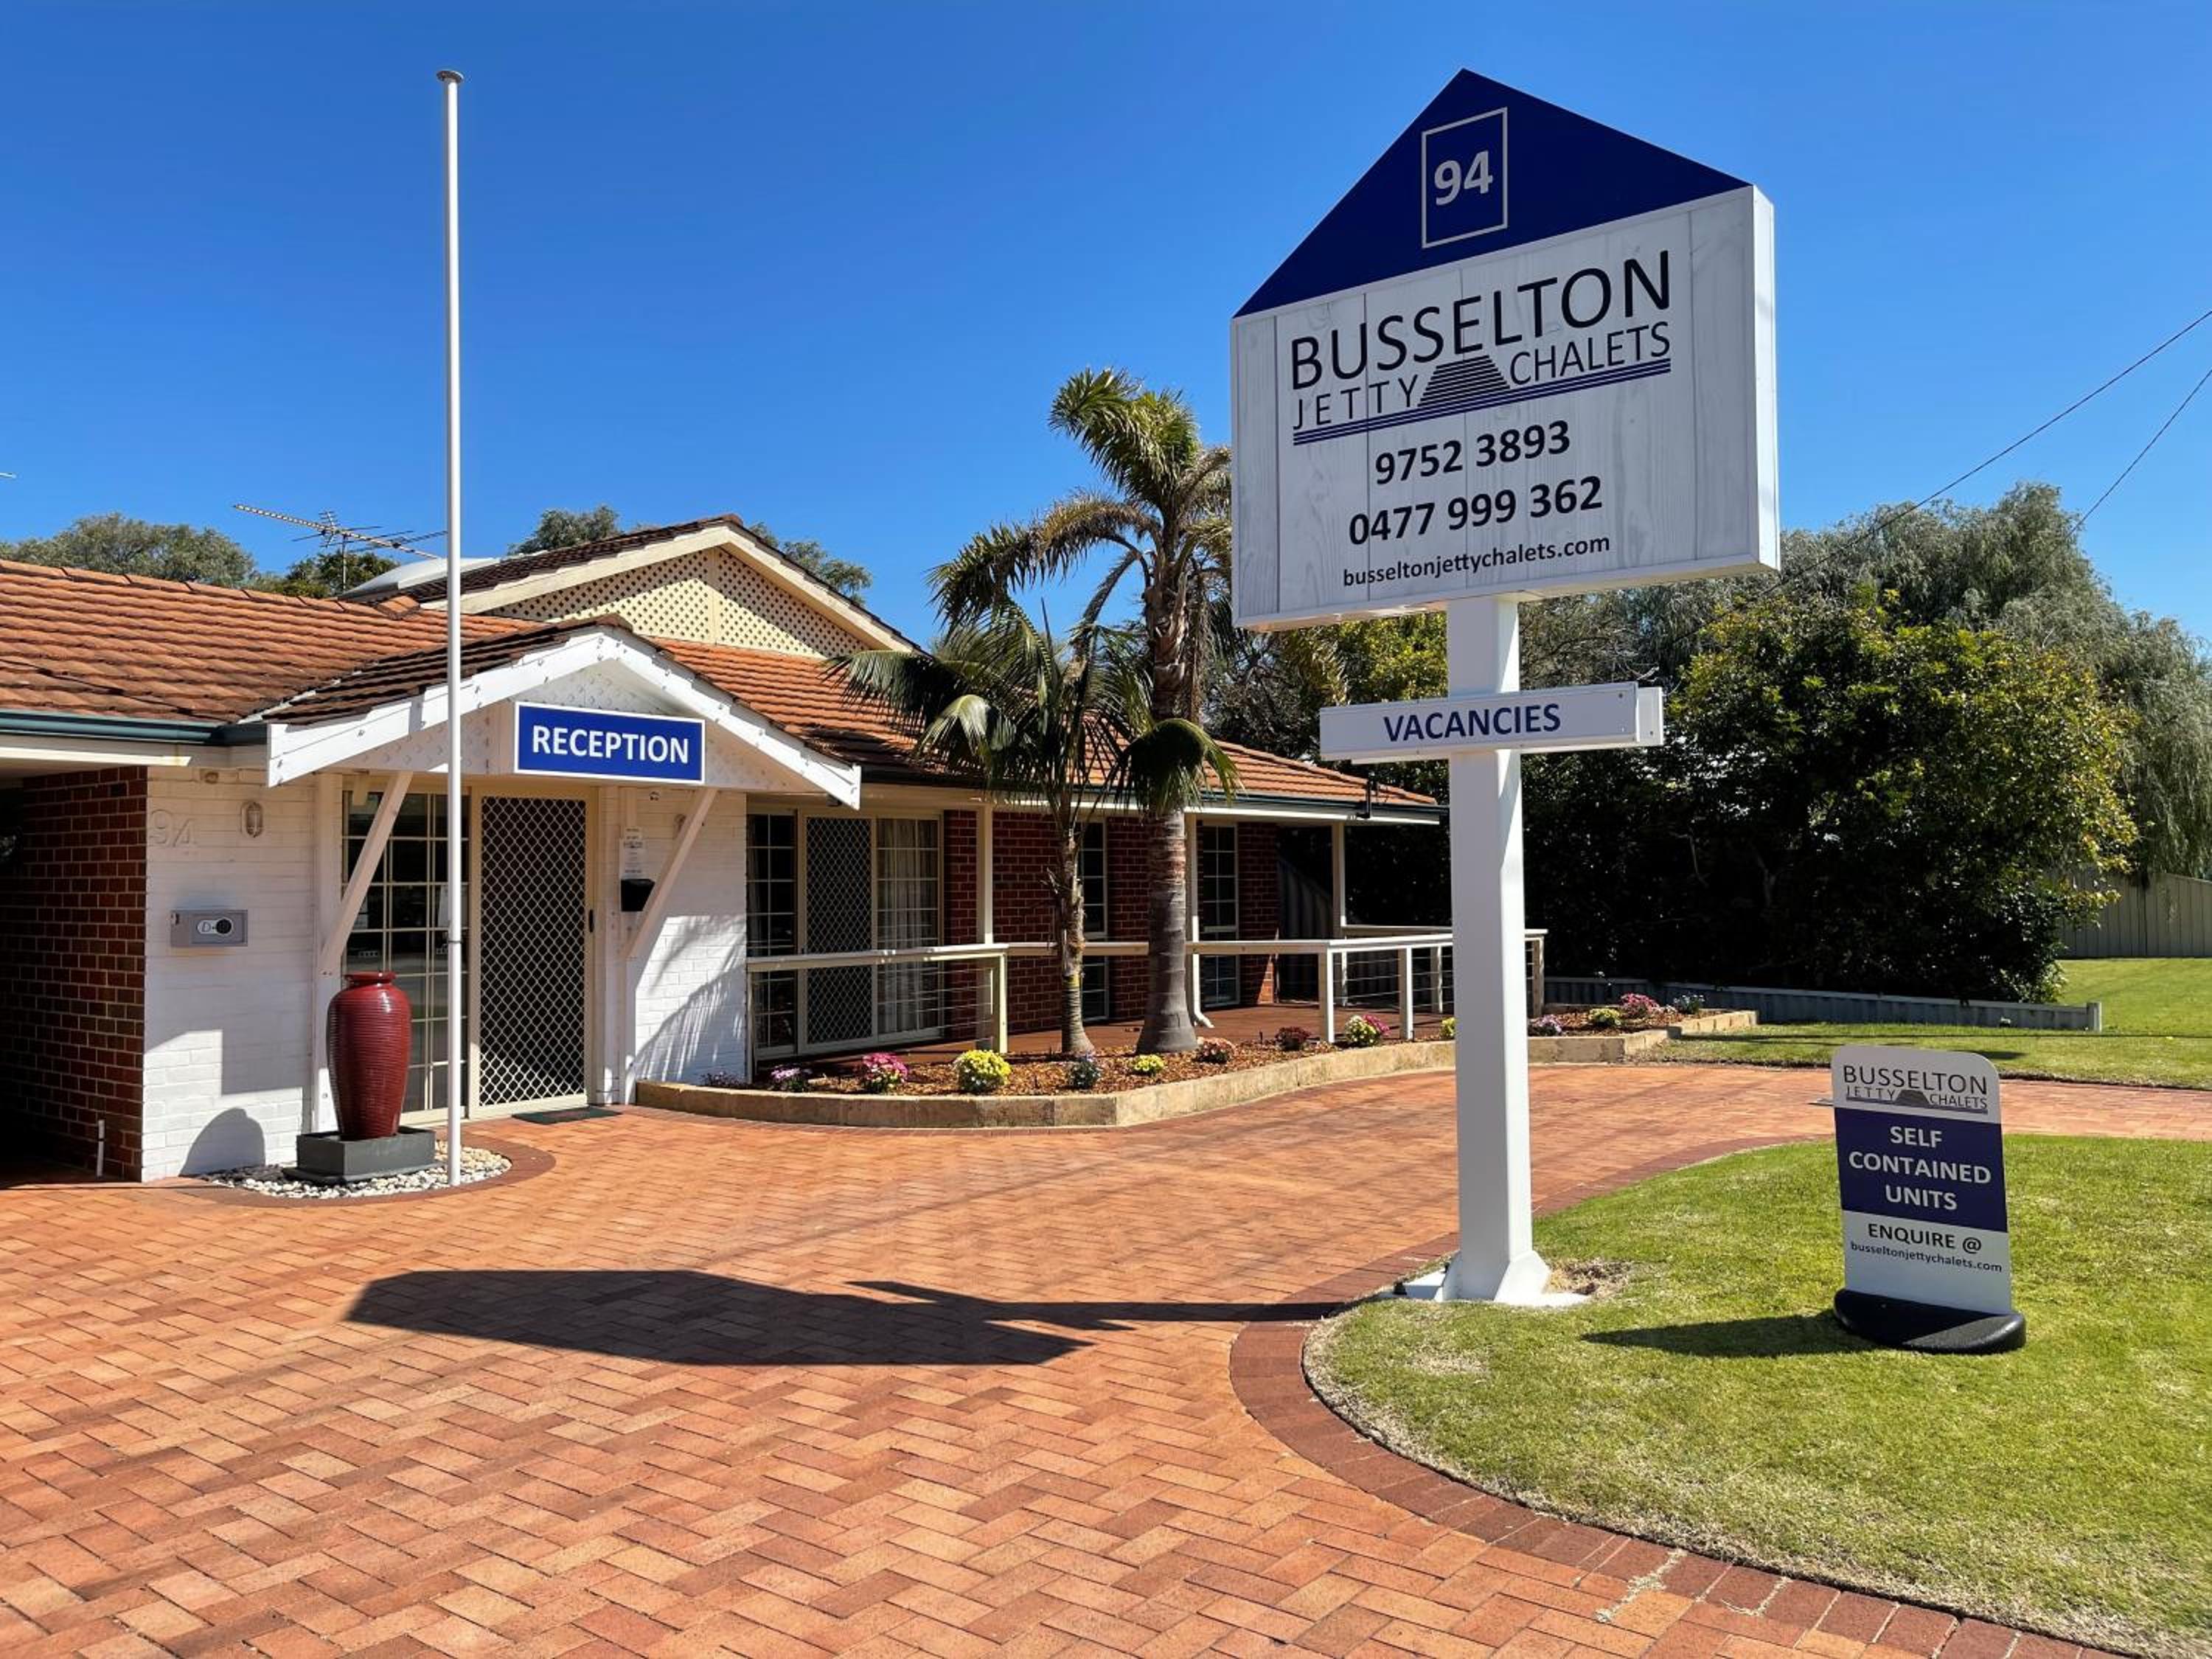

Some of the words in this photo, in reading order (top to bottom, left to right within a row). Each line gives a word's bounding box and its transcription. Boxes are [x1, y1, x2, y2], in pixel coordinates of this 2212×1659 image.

[1433, 150, 1494, 206] 94
[1291, 251, 1672, 390] BUSSELTON
[1293, 375, 1419, 431] JETTY
[1509, 321, 1671, 385] CHALETS
[1375, 440, 1462, 485] 9752
[1476, 420, 1571, 467] 3893
[1349, 502, 1435, 545] 0477
[1447, 489, 1517, 531] 999
[1530, 476, 1602, 519] 362
[1343, 535, 1610, 588] busseltonjettychalets.com
[1384, 703, 1561, 742] VACANCIES
[532, 725, 689, 764] RECEPTION
[1844, 1065, 1987, 1095] BUSSELTON
[1846, 1085, 1896, 1101] JETTY
[1930, 1093, 1987, 1109] CHALETS
[1890, 1126, 1942, 1148] SELF
[1848, 1151, 1992, 1184] CONTAINED
[1885, 1184, 1958, 1211] UNITS
[1851, 1242, 2003, 1273] busseltonjettychalets.com
[1868, 1223, 1956, 1249] ENQUIRE
[1962, 1237, 1982, 1253] @
